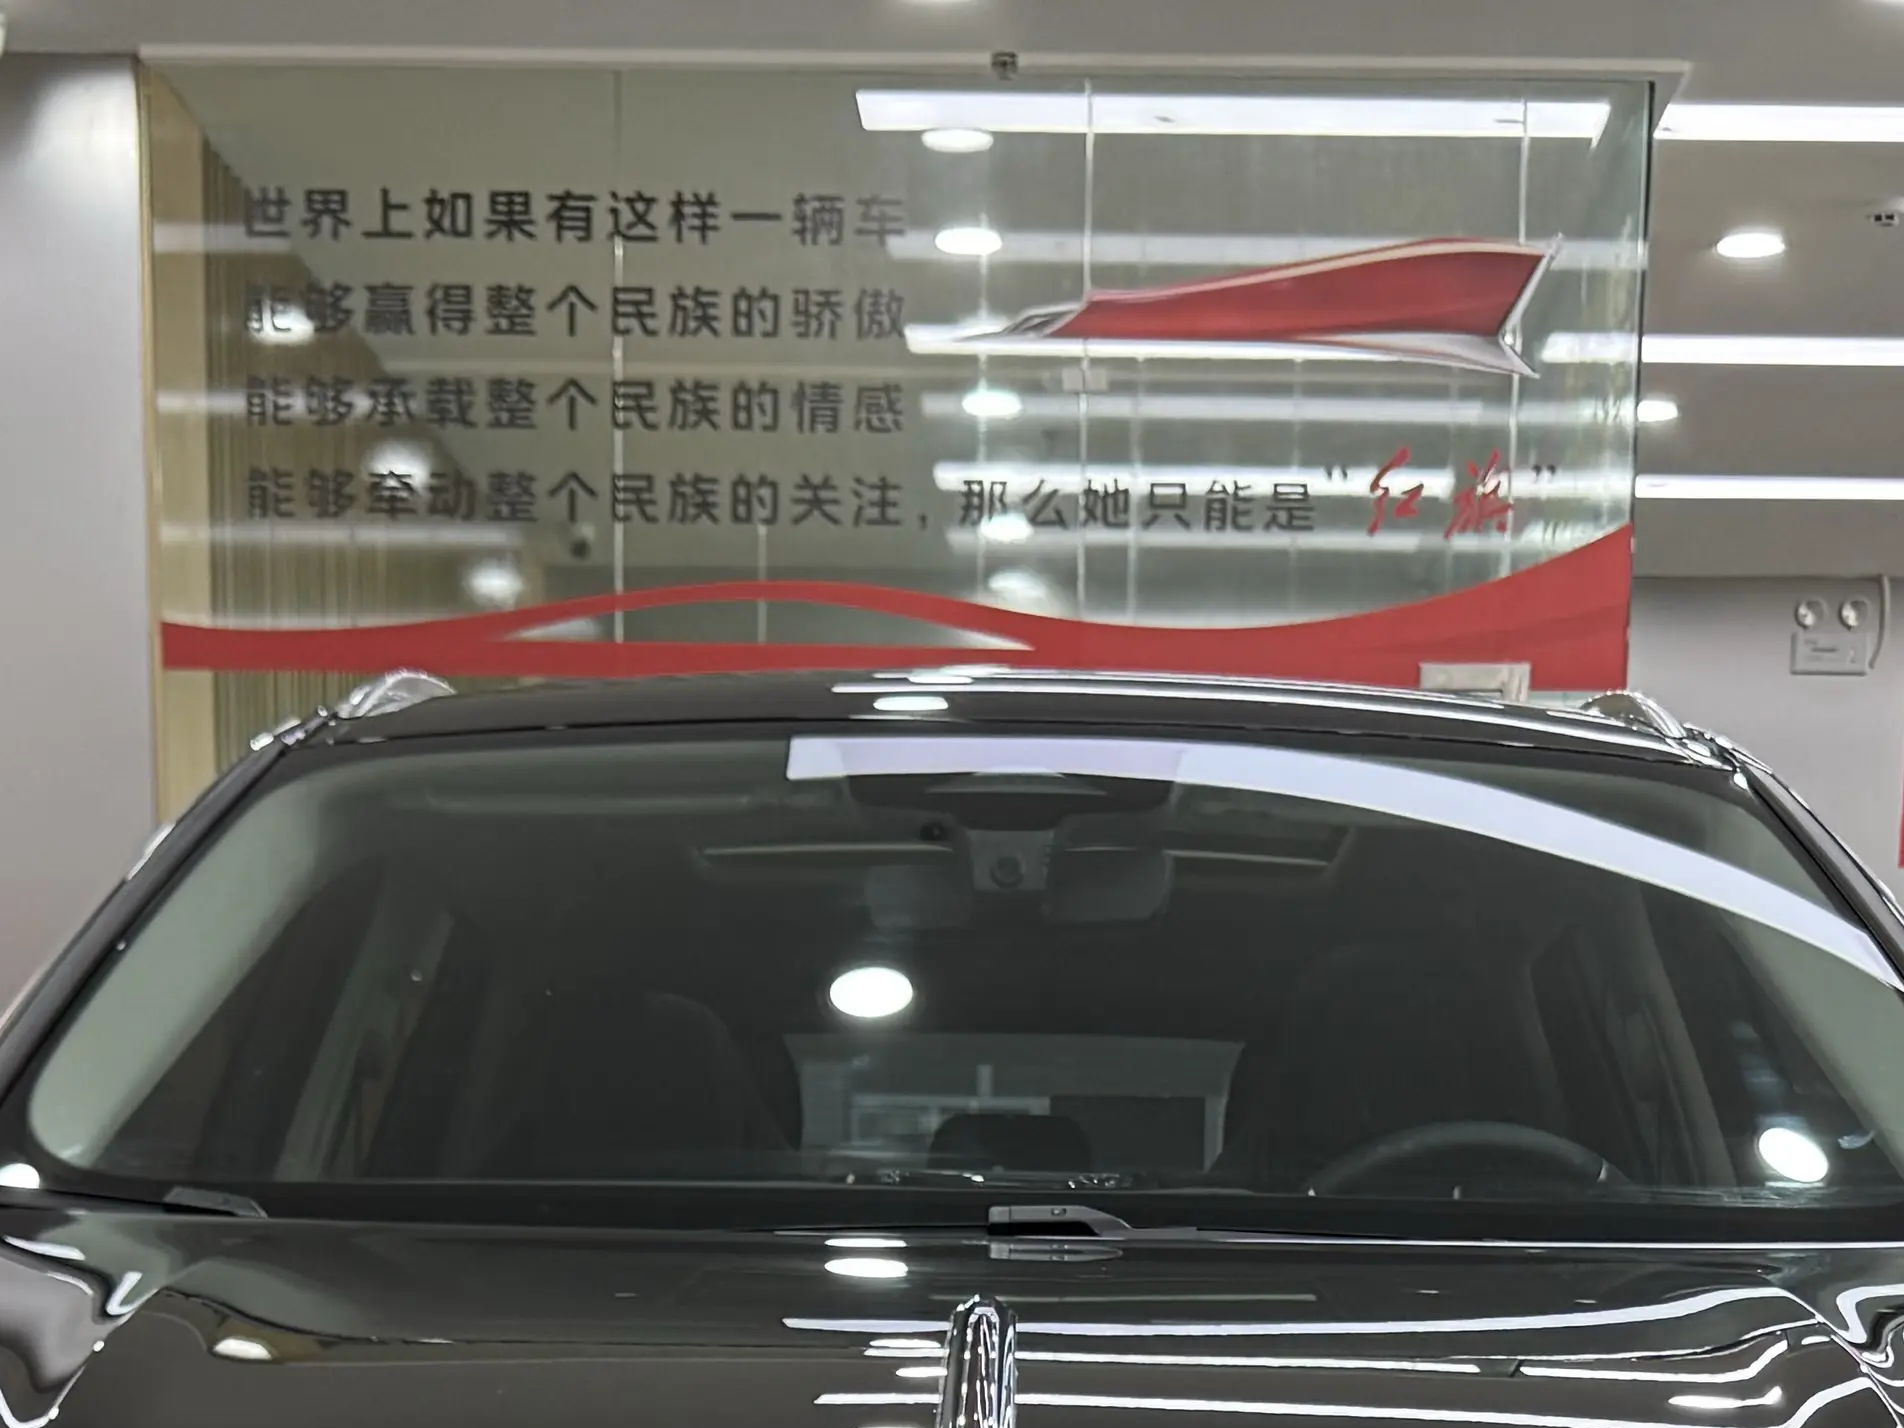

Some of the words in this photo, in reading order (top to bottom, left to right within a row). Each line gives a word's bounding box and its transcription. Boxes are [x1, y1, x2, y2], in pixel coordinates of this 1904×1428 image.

[242, 187, 908, 246] 世界上如果有这样一辆车
[243, 283, 906, 341] 能够赢得整个民族的骄傲
[245, 377, 905, 434] 能够承载整个民族的情感
